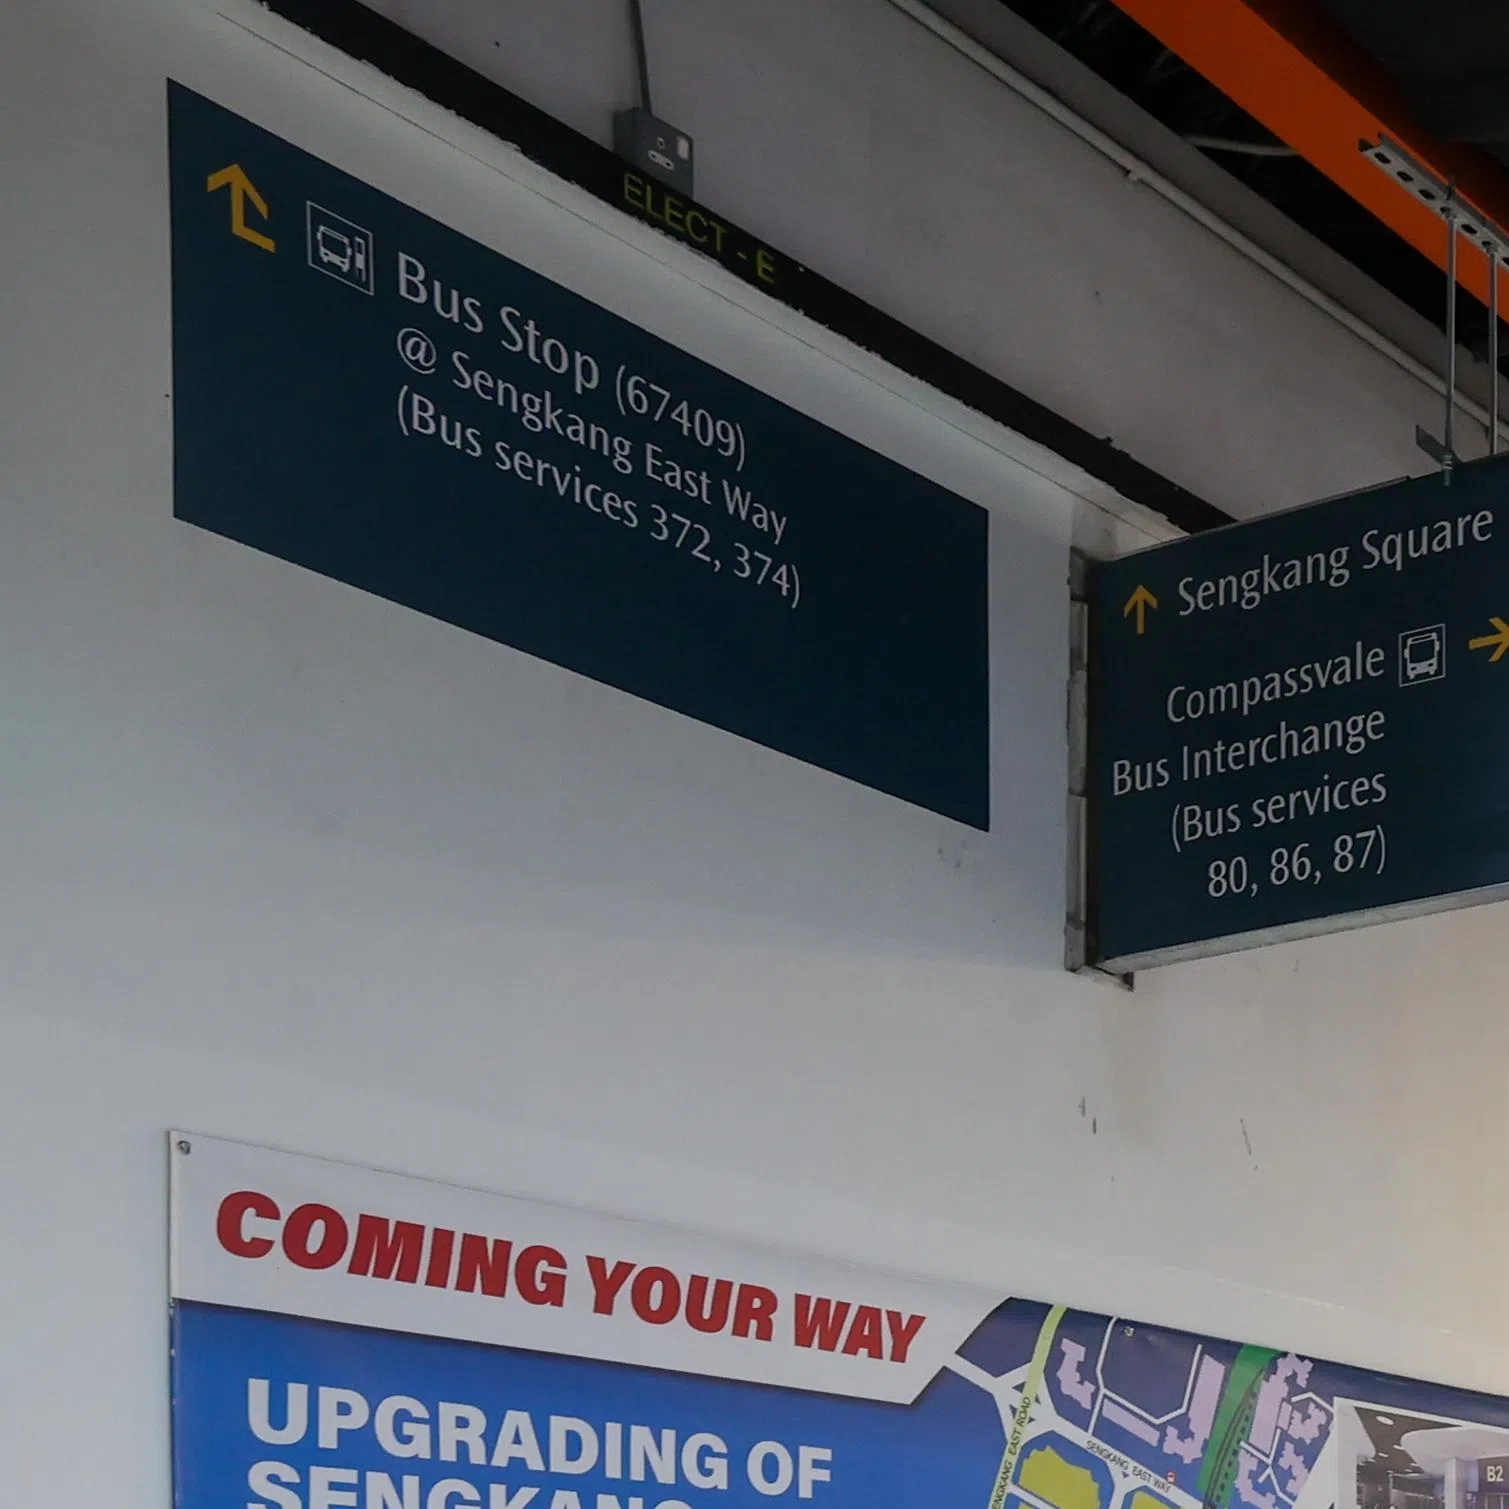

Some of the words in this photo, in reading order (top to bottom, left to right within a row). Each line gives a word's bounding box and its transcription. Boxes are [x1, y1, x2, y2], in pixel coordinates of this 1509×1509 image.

[622, 171, 728, 255] ELECT
[754, 247, 776, 285] E
[397, 251, 485, 334] Bus
[499, 304, 600, 393] Stop
[615, 364, 749, 472] (67409)
[397, 327, 438, 377] @
[450, 350, 635, 474] Sengkang
[644, 444, 712, 508] East
[722, 479, 788, 545] Way
[397, 384, 483, 460] (Bus
[494, 439, 640, 529] services
[649, 504, 723, 572] 372,
[732, 543, 803, 608] 374)
[1177, 537, 1350, 618] Sengkang
[1361, 506, 1495, 578] Square
[1166, 641, 1386, 727] Compassvale
[1112, 752, 1171, 796] Bus
[1181, 708, 1387, 783] Interchange
[1170, 798, 1241, 855] (Bus
[1251, 770, 1388, 830] services
[1207, 854, 1259, 901] 80,
[1268, 843, 1322, 890] 86,
[1332, 824, 1388, 878] 87)
[215, 1190, 568, 1309] COMING
[585, 1255, 779, 1343] YOUR
[794, 1292, 927, 1366] WAY
[247, 1377, 729, 1492] UPGRADING
[746, 1440, 835, 1500] OF
[1008, 1429, 1023, 1456] EAST
[1016, 1396, 1031, 1428] ROAD
[1086, 1440, 1129, 1471] SENGKANG
[1132, 1465, 1154, 1482] EAST
[1153, 1476, 1171, 1493] WAY
[1487, 1464, 1504, 1483] B2
